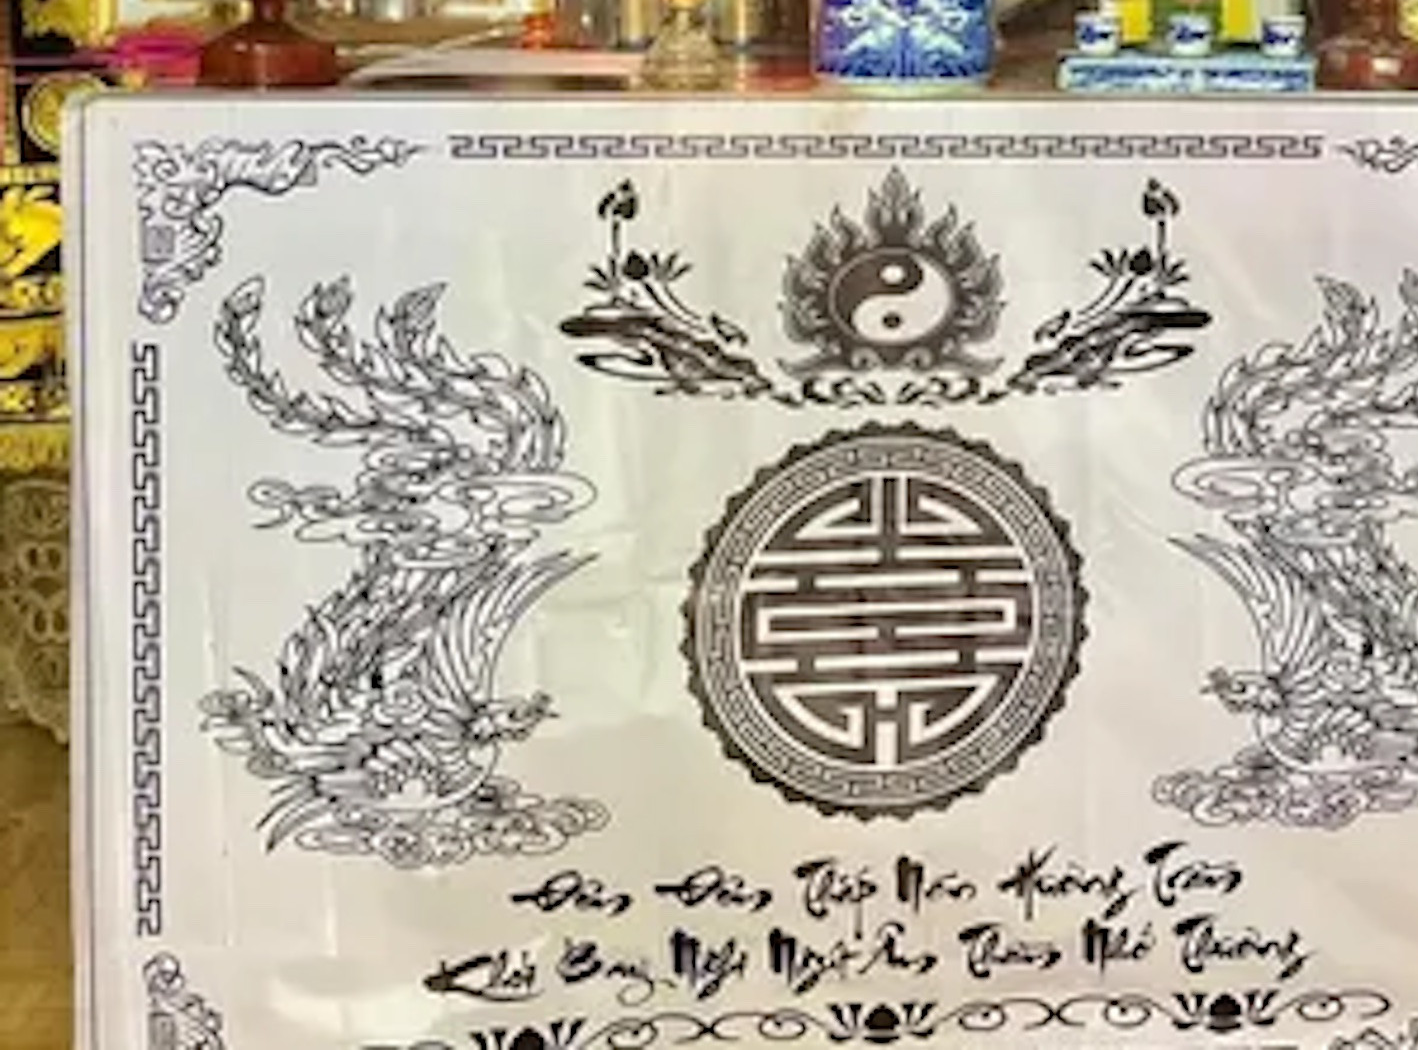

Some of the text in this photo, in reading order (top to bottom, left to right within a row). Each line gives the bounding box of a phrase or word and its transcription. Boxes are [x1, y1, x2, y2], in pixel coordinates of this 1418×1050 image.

[793, 857, 877, 940] Thắp
[997, 846, 1137, 920] Hương
[556, 936, 664, 1007] Bay
[1172, 915, 1310, 982] Thương
